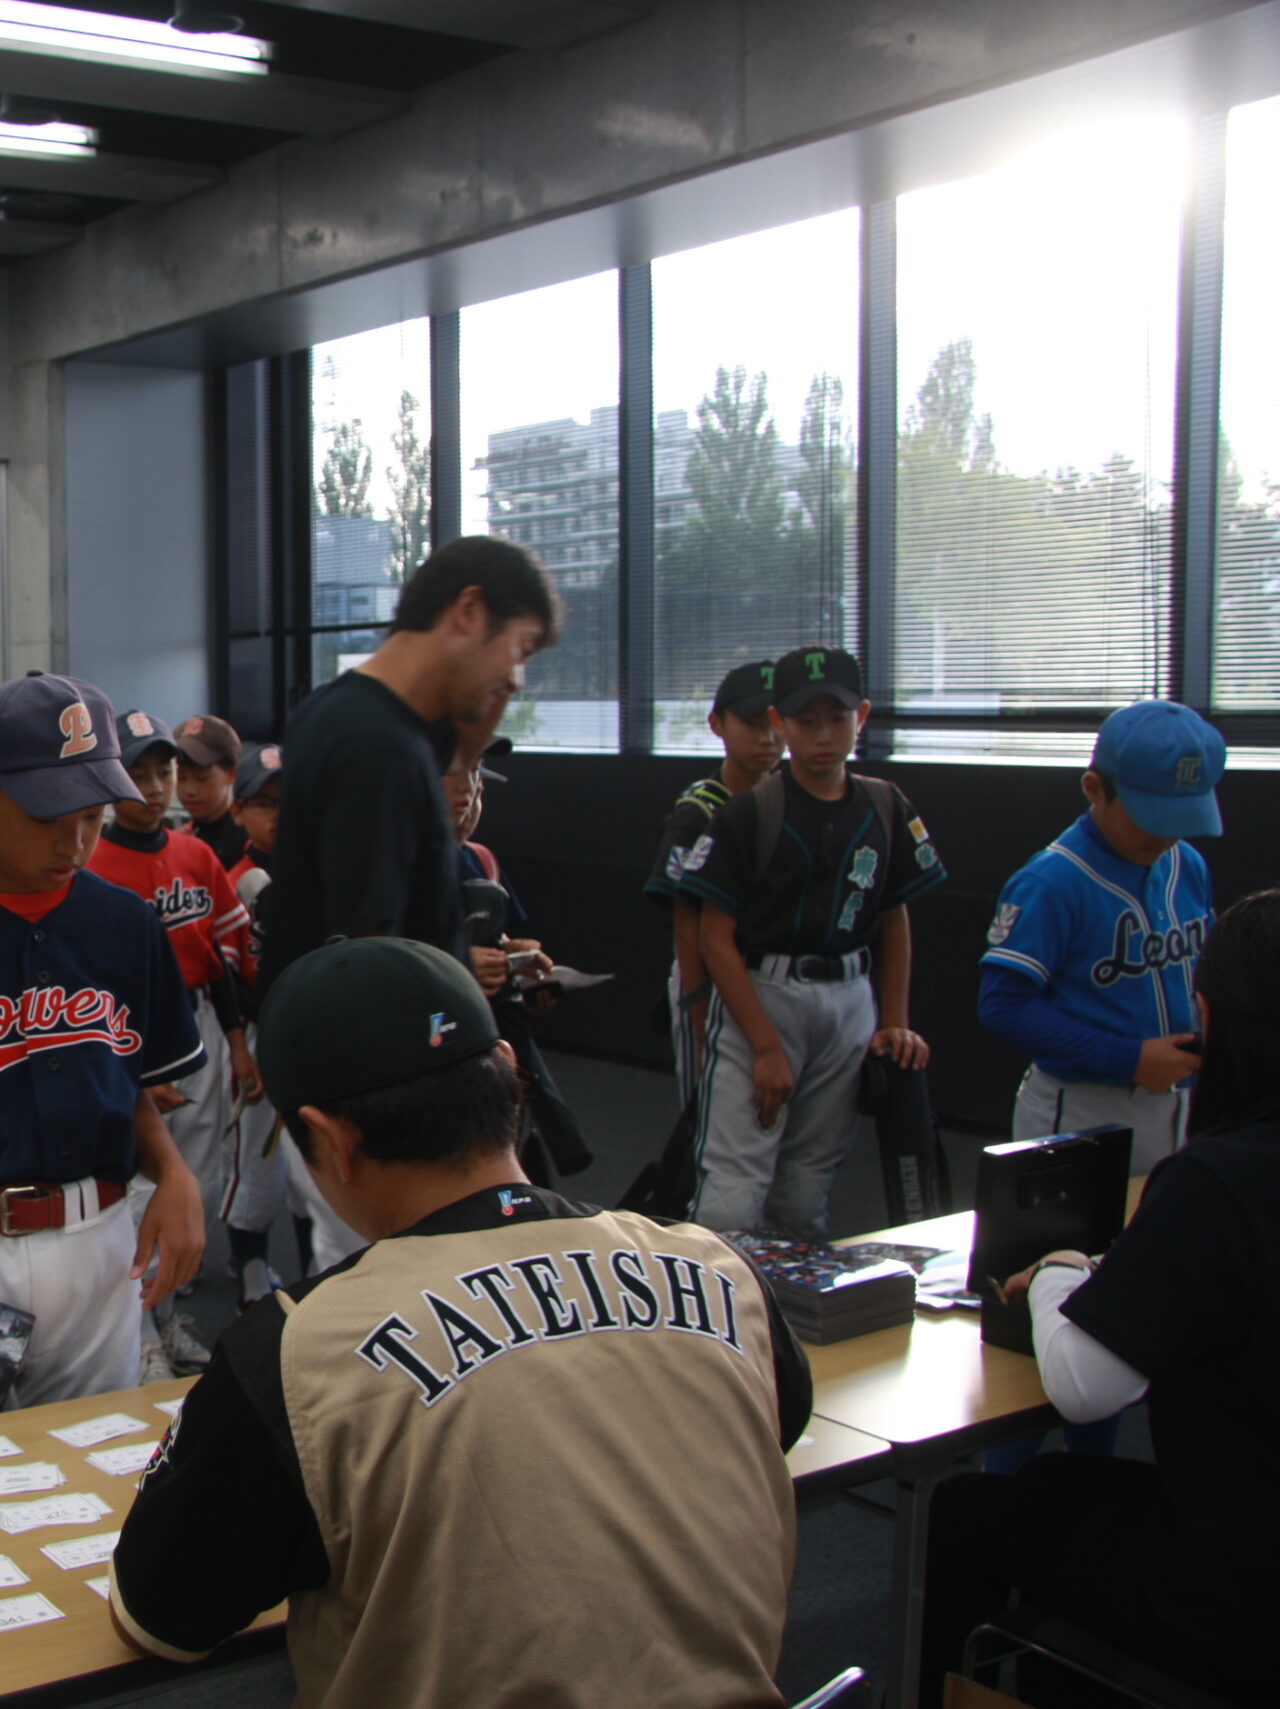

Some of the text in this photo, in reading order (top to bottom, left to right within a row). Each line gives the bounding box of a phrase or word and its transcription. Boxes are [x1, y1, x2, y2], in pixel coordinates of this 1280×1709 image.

[803, 651, 826, 681] T
[58, 702, 98, 759] P
[1091, 908, 1207, 988] Leon
[355, 1249, 744, 1408] TATEISHI
